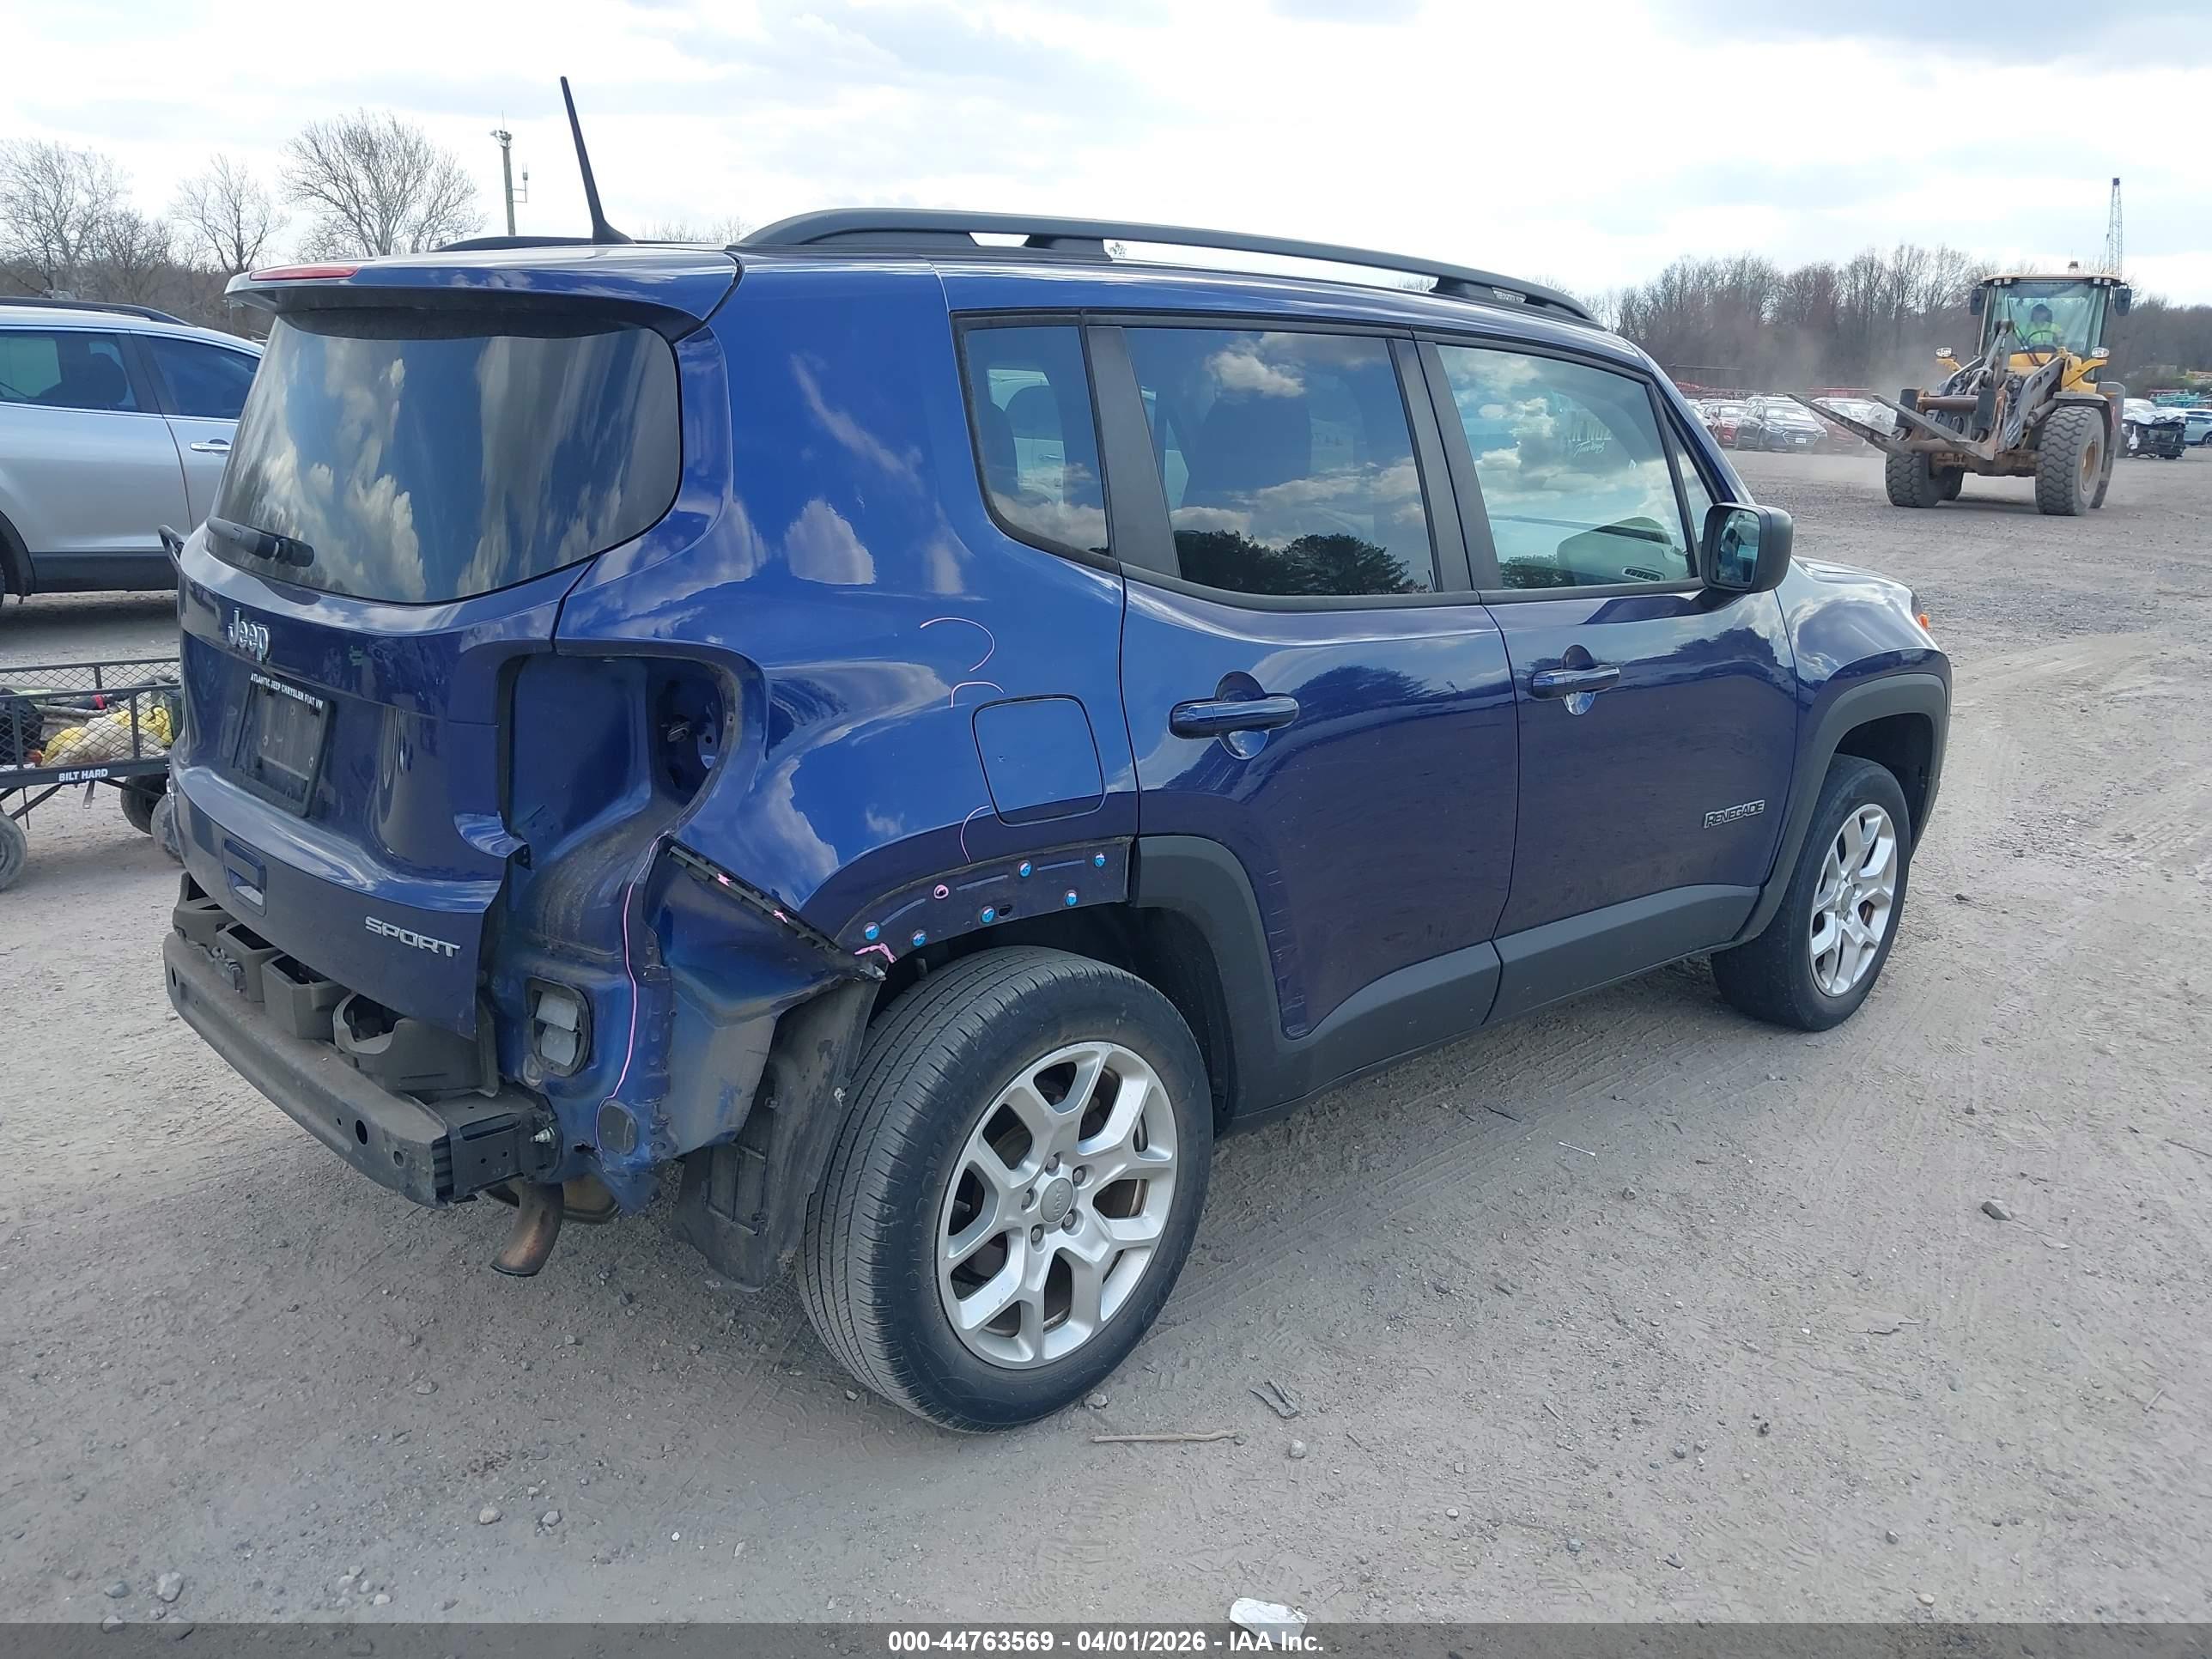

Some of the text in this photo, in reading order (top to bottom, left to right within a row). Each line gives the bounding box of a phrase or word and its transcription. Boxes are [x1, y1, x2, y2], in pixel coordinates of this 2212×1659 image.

[228, 607, 270, 662] Jeep
[250, 672, 324, 710] ATLANTIC JEEP CHRYSLER FIAT VW
[58, 768, 108, 782] BILT HARD
[1703, 799, 1765, 830] RENEGADE
[365, 915, 461, 957] SPORT
